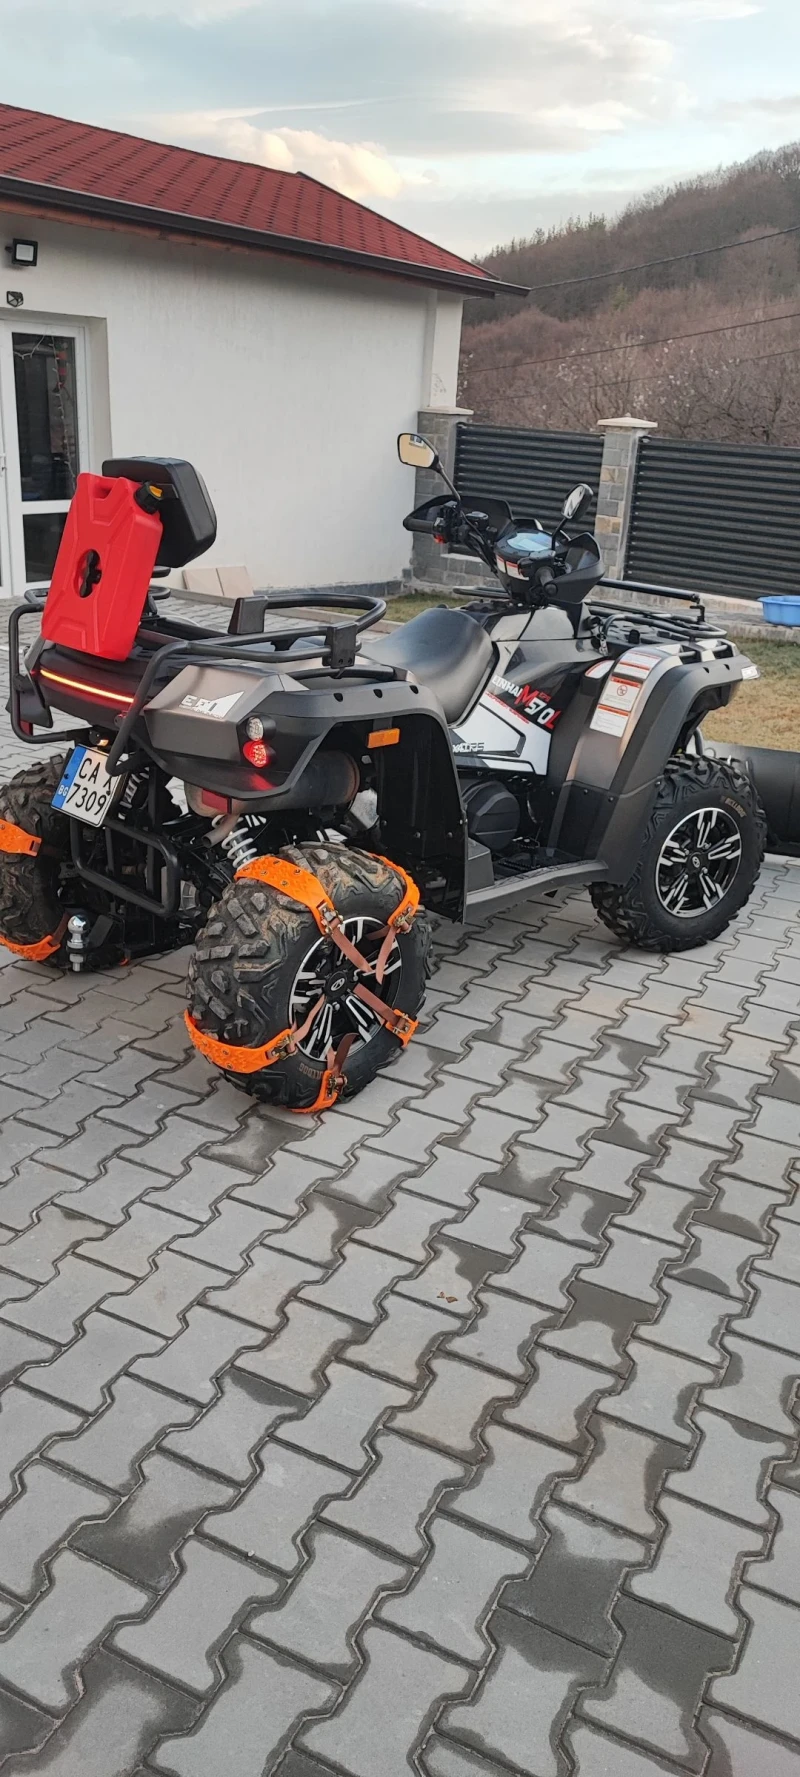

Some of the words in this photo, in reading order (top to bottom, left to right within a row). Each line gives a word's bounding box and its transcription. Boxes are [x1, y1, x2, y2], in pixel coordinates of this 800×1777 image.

[491, 675, 523, 698] LINHAI
[79, 757, 101, 784] CA
[57, 784, 69, 797] BG
[66, 782, 107, 816] 7309
